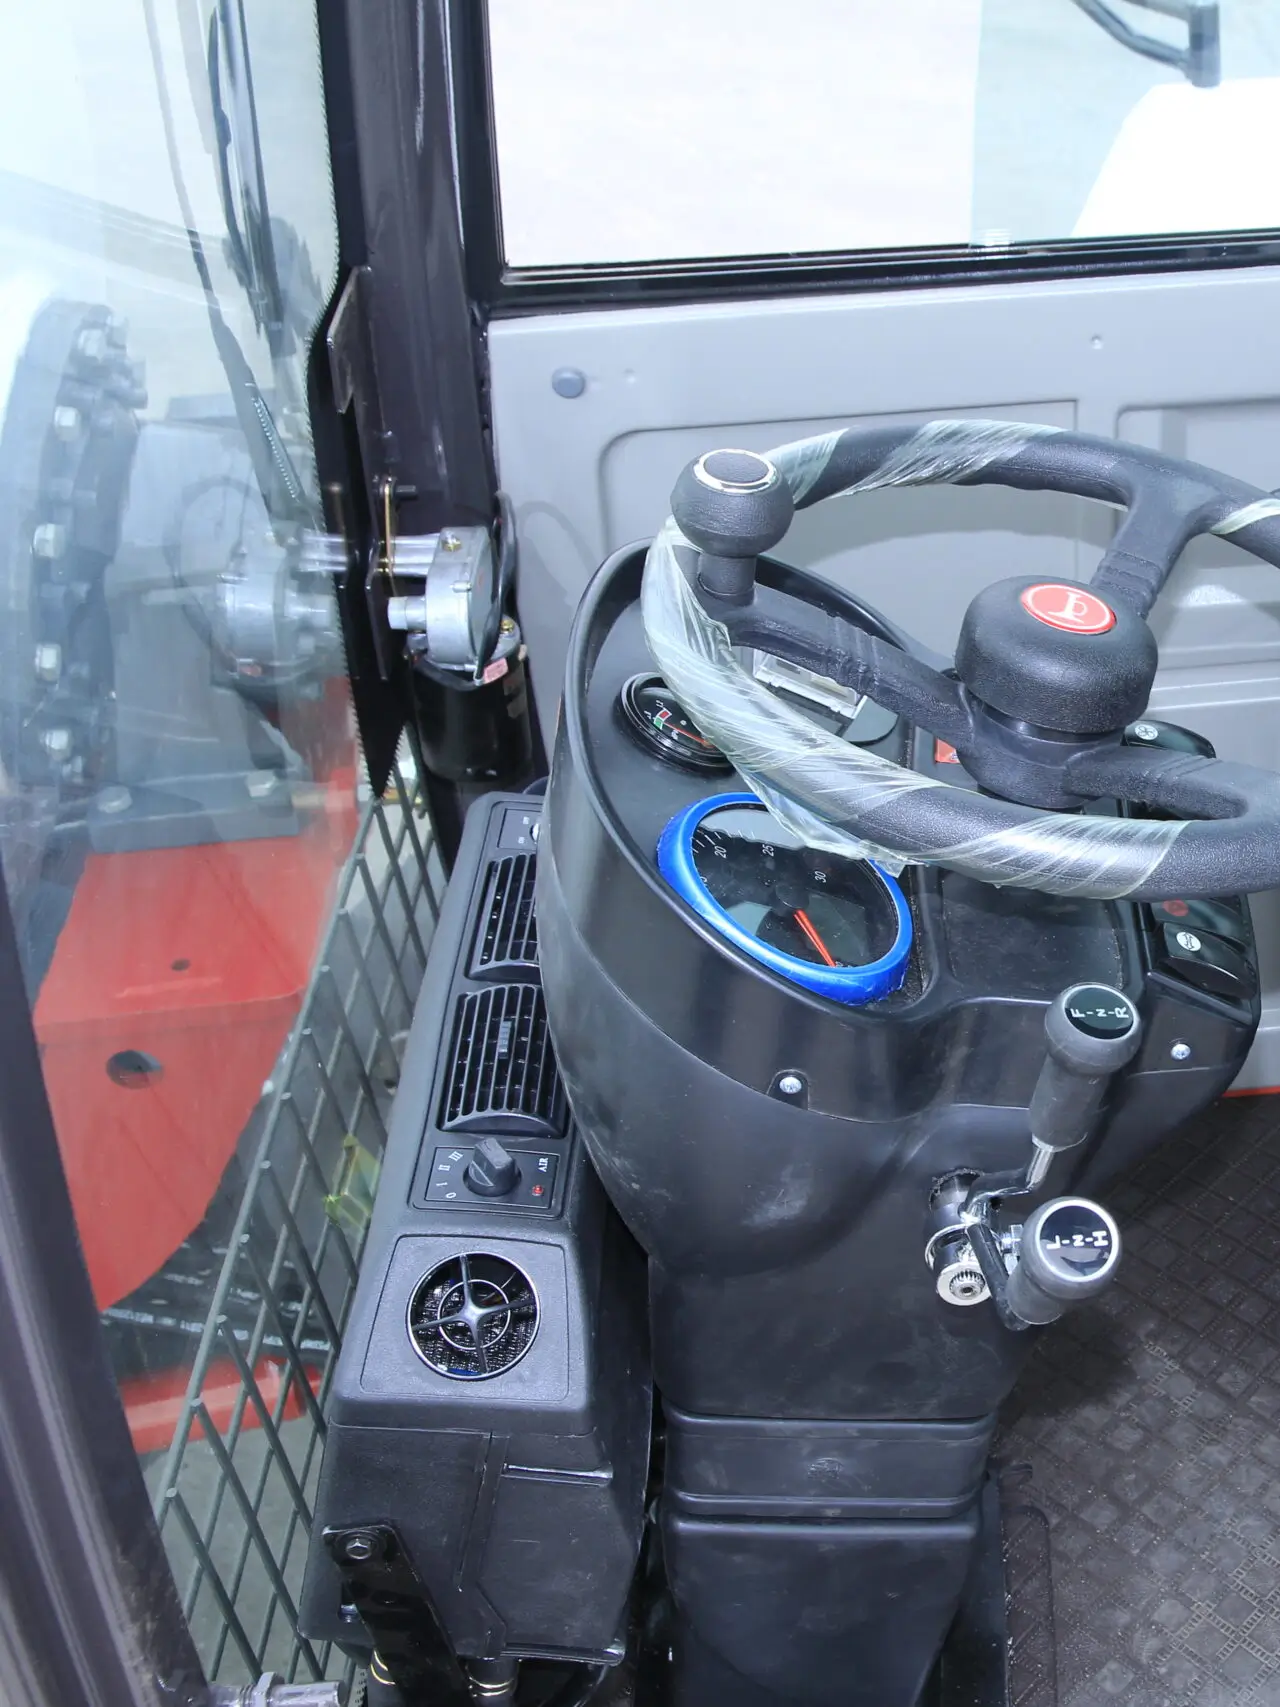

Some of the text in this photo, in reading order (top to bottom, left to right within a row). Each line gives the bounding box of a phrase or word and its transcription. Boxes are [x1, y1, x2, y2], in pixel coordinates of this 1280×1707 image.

[714, 845, 727, 858] 20
[762, 844, 775, 857] 25
[814, 871, 827, 884] 30
[538, 1157, 549, 1172] AIR
